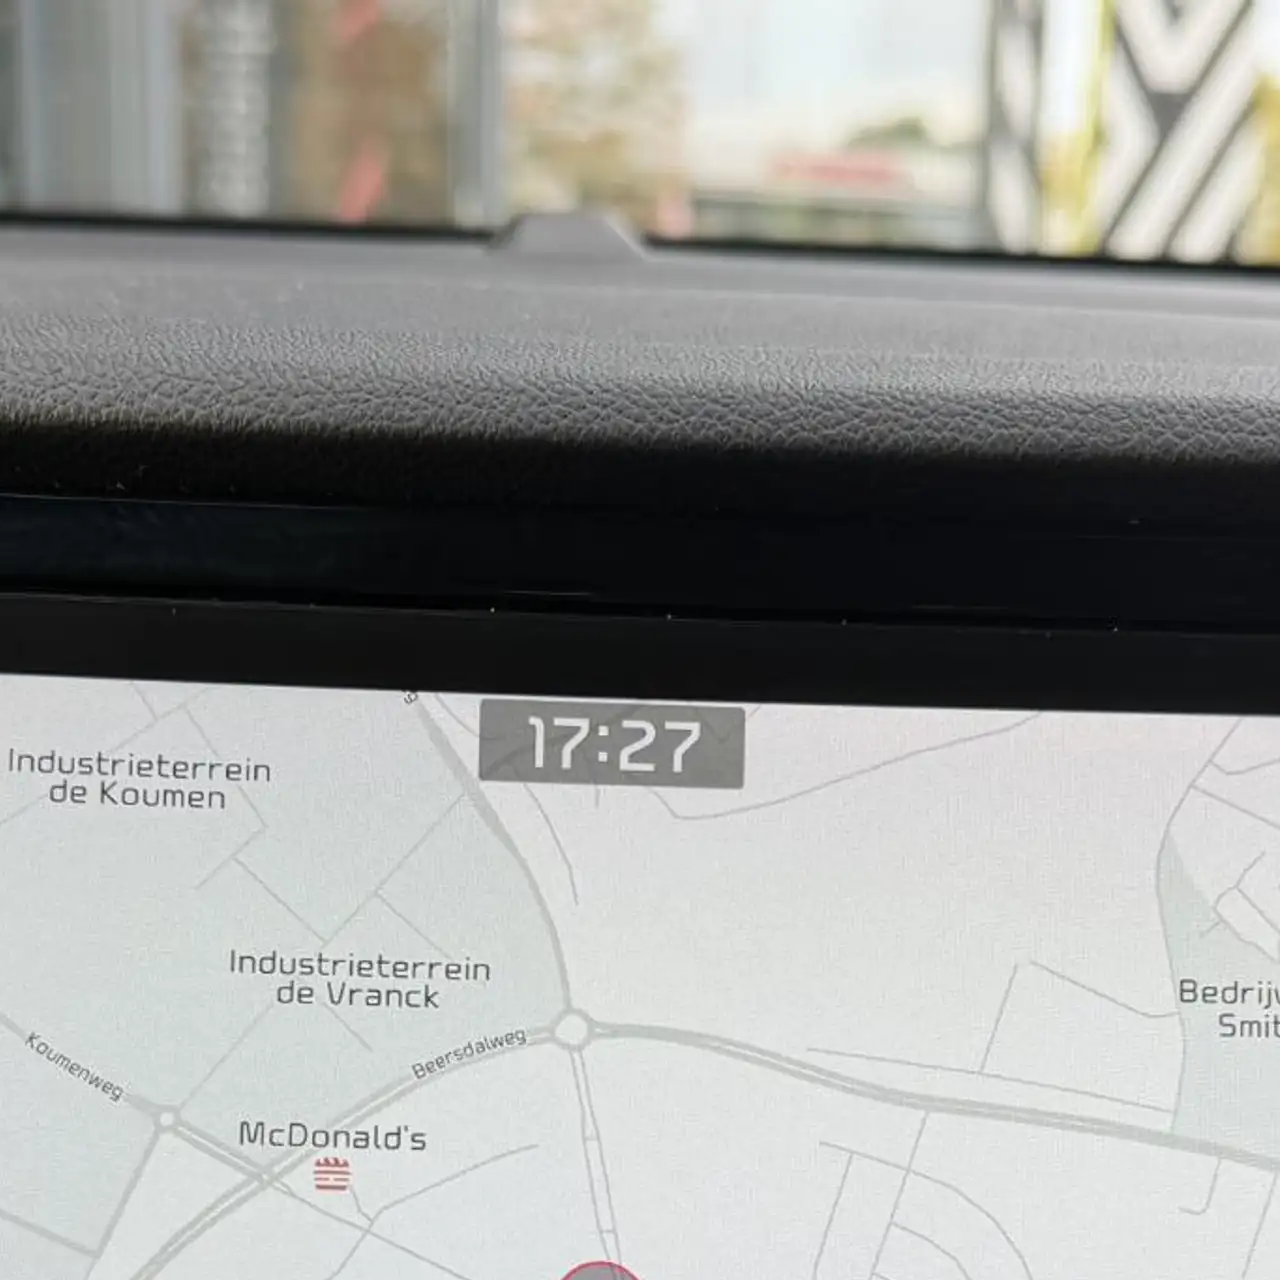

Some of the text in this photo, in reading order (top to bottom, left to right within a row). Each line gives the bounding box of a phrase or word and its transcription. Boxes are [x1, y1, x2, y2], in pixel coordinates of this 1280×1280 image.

[527, 715, 701, 773] 17:27
[8, 748, 272, 782] Industrieterrein
[49, 779, 226, 809] de Koumen
[229, 949, 491, 982] Industrieterrein
[276, 980, 441, 1009] de Vranck
[25, 1031, 124, 1103] Koumenweg
[411, 1028, 528, 1080] Beersdalweg
[239, 1120, 428, 1151] McDonald's
